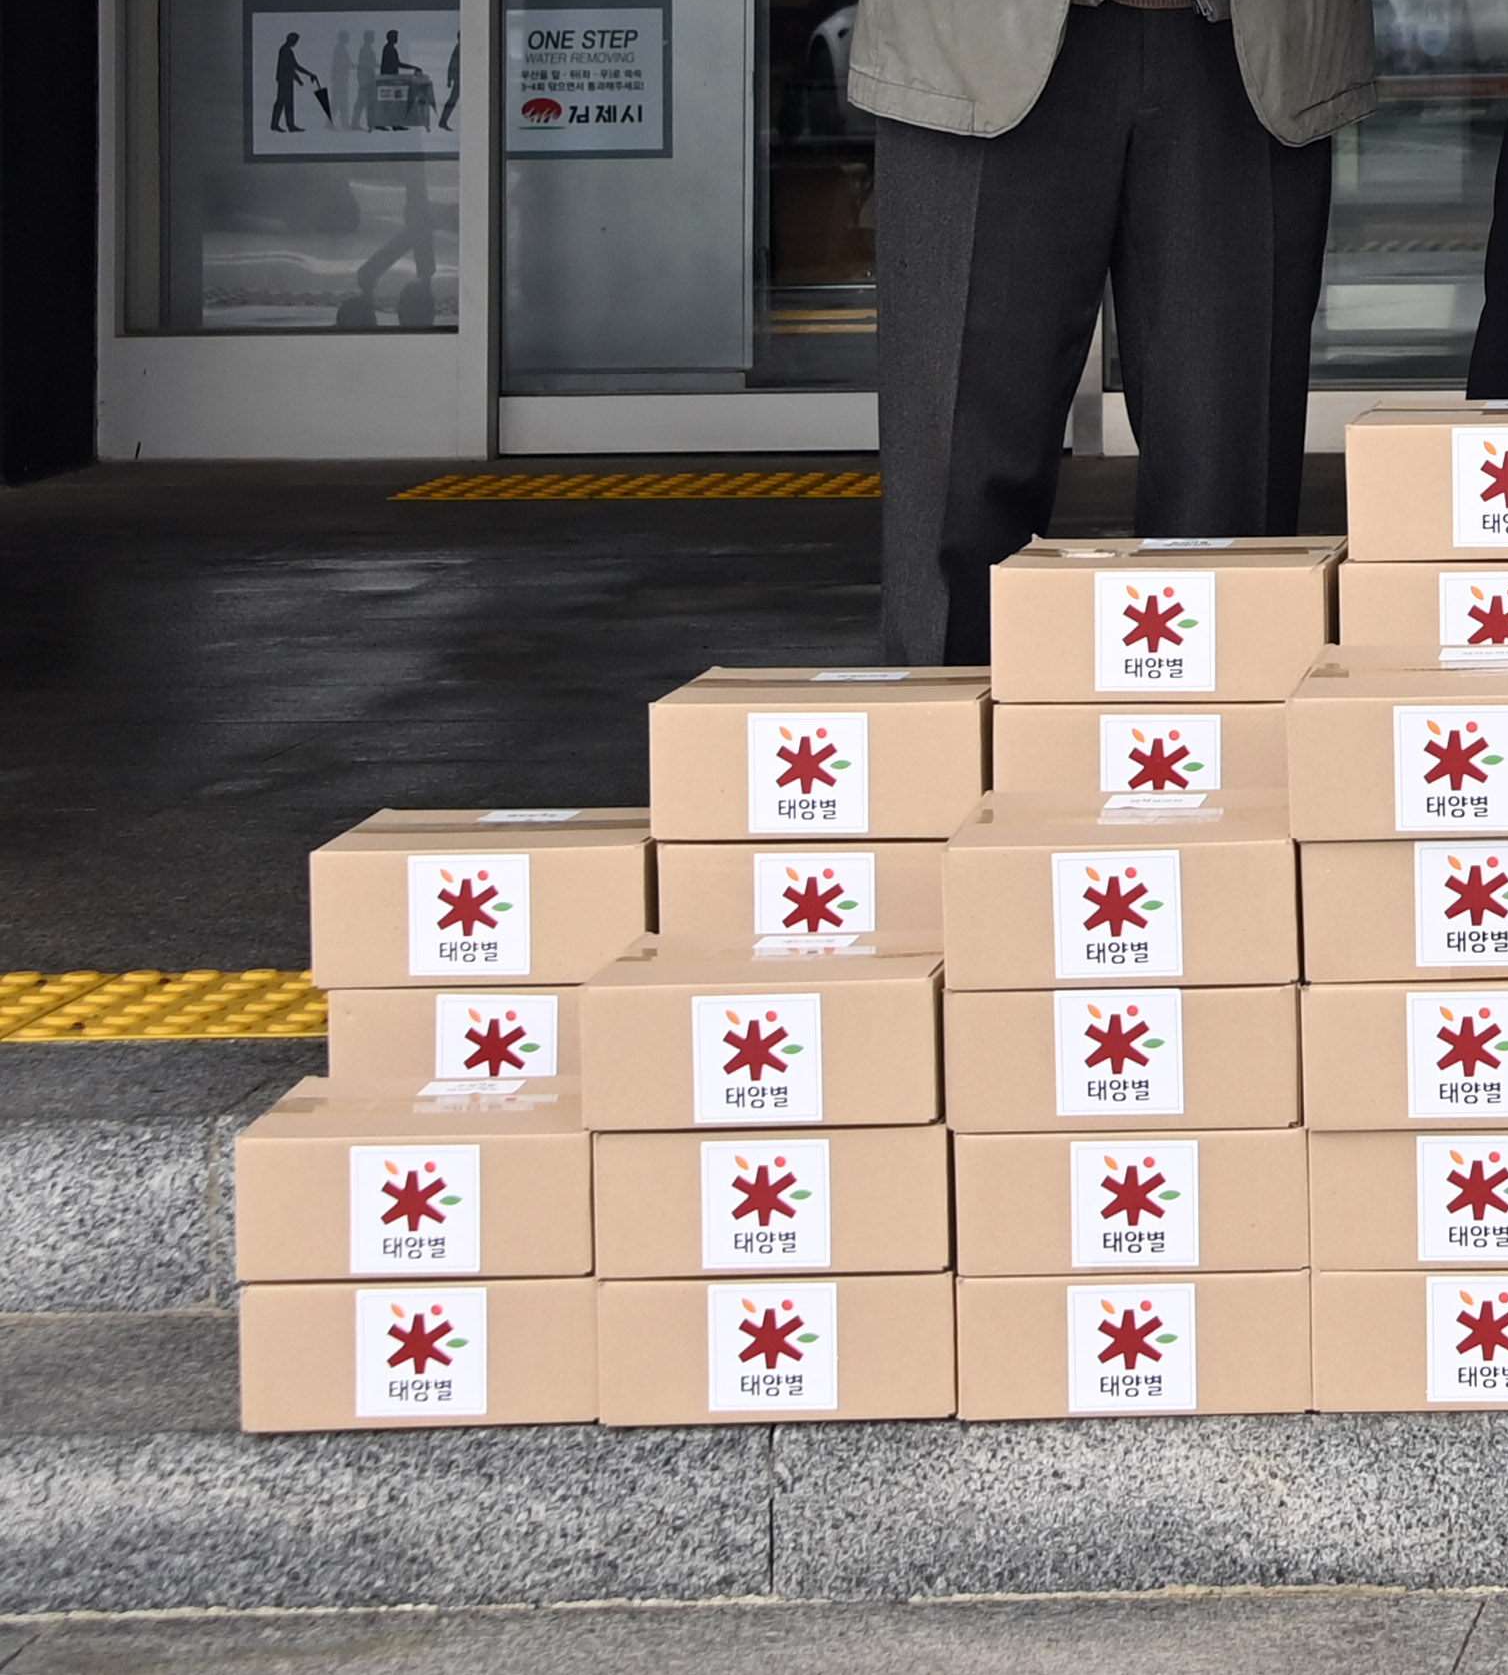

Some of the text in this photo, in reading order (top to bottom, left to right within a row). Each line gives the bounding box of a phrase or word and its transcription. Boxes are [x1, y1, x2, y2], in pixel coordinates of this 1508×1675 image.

[527, 30, 638, 50] ONE STEP
[525, 52, 635, 65] WATER REMOVING
[568, 105, 643, 124] 김제시
[1124, 657, 1183, 679] 태양별
[778, 799, 836, 820] 태양별
[1426, 795, 1488, 818] 태양별
[439, 941, 498, 963] 태양별
[1086, 941, 1148, 965] 태양별
[1446, 930, 1508, 954] 태양별
[725, 1086, 788, 1109] 태양별
[1087, 1079, 1149, 1102] 태양별
[1439, 1082, 1501, 1105] 태양별
[383, 1237, 445, 1259] 태양별
[734, 1231, 796, 1254] 태양별
[1102, 1231, 1165, 1254] 태양별
[389, 1380, 452, 1402] 태양별
[740, 1374, 803, 1397] 태양별
[1100, 1375, 1162, 1398] 태양별
